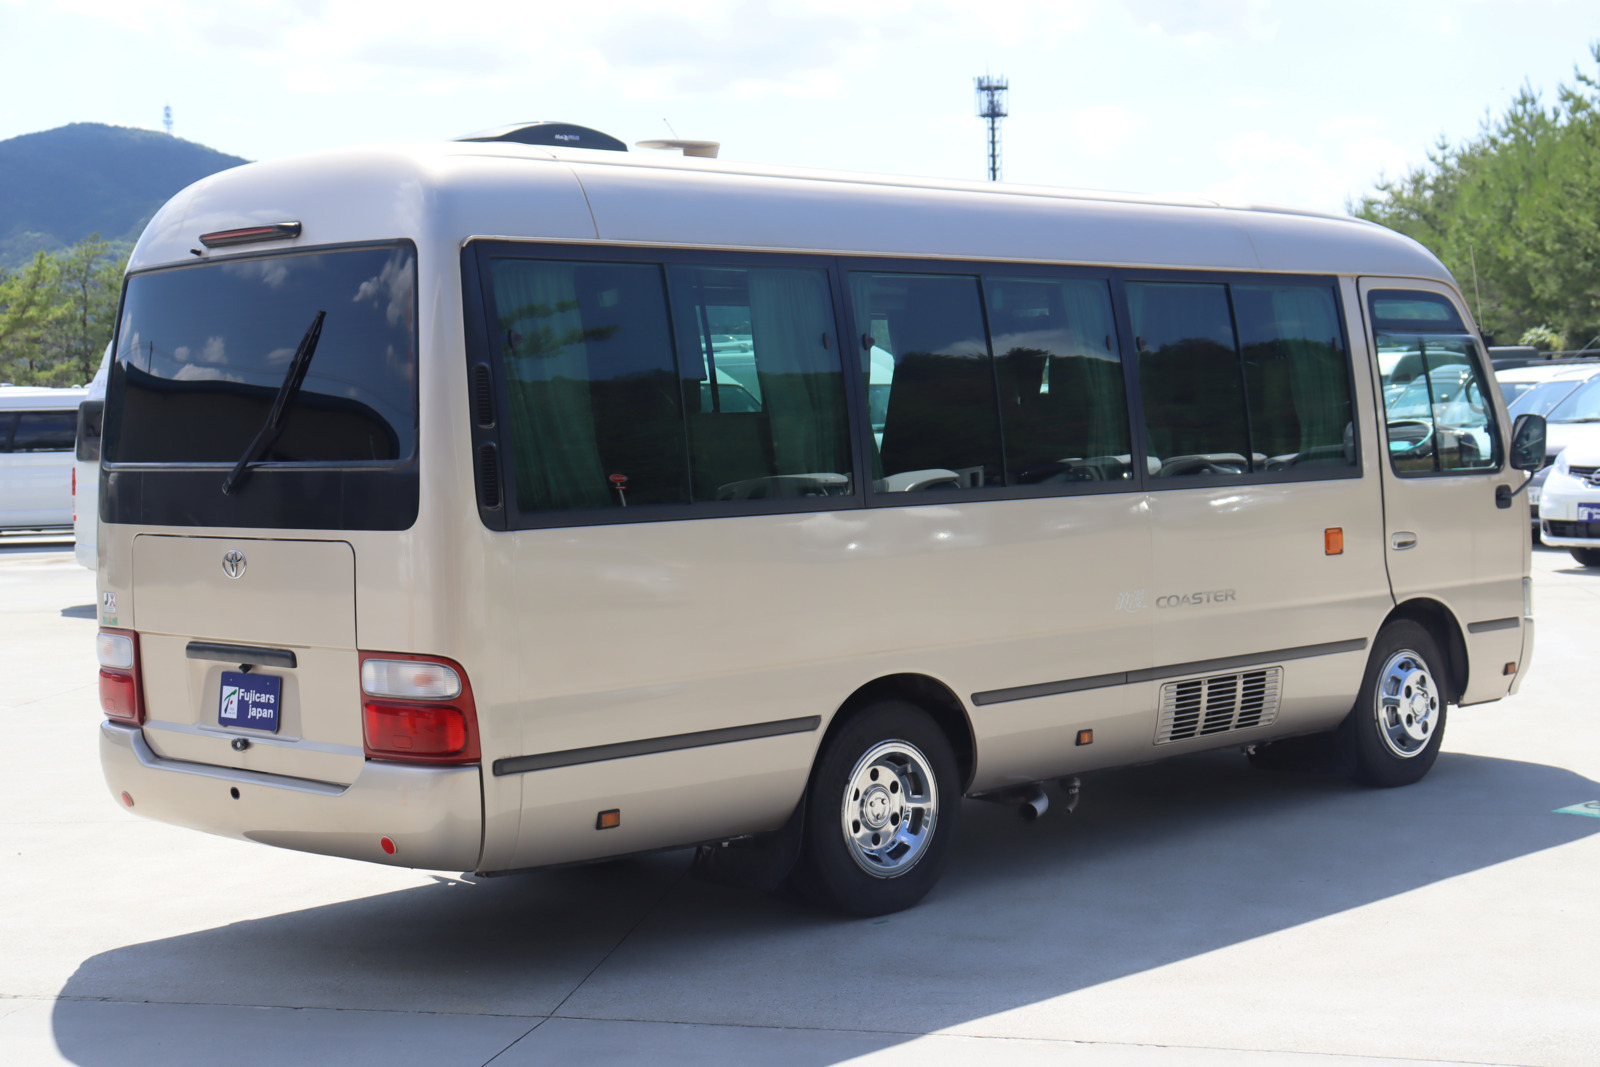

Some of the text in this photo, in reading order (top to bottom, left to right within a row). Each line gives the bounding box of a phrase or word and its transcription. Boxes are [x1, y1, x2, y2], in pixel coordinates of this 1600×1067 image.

[1155, 588, 1236, 609] COASTER
[239, 688, 275, 704] Fujicars
[247, 704, 274, 719] japan
